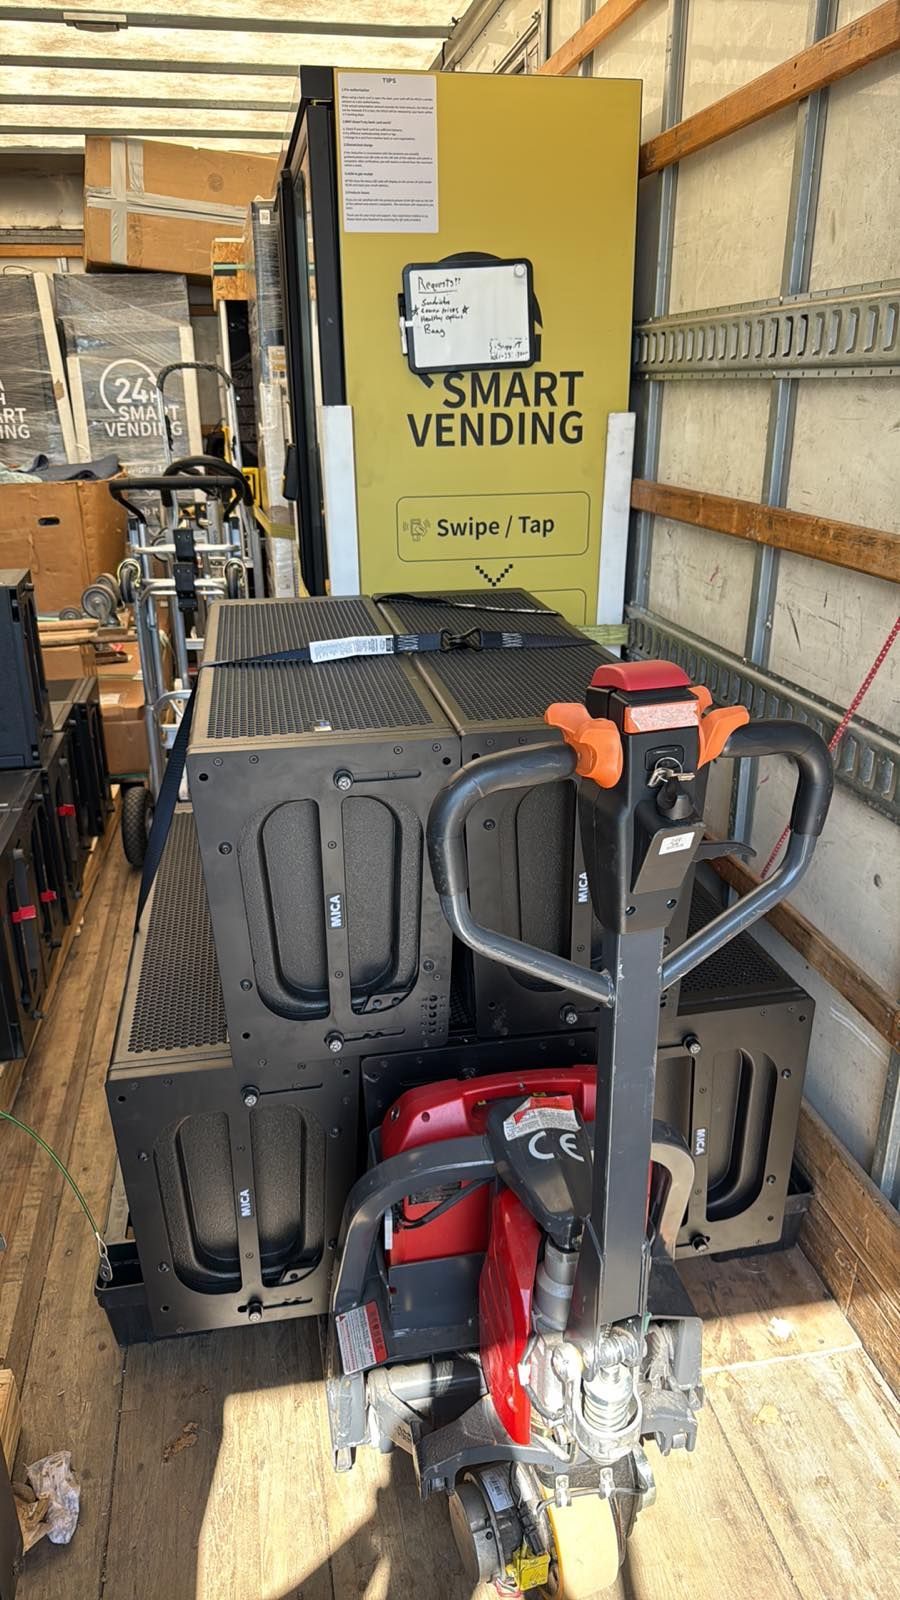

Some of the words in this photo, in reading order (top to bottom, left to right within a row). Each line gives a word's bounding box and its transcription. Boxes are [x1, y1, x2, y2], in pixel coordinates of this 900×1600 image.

[443, 371, 584, 408] SMART
[0, 408, 27, 424] RT
[118, 405, 180, 421] SMAT
[407, 411, 583, 447] VENDING
[437, 516, 500, 540] Swipe
[505, 515, 513, 538] /
[518, 516, 555, 537] Tap
[578, 872, 588, 903] MICA
[330, 895, 341, 927] MICA
[528, 1130, 585, 1162] CE
[695, 1129, 705, 1155] MICA
[240, 1189, 251, 1216] MICA
